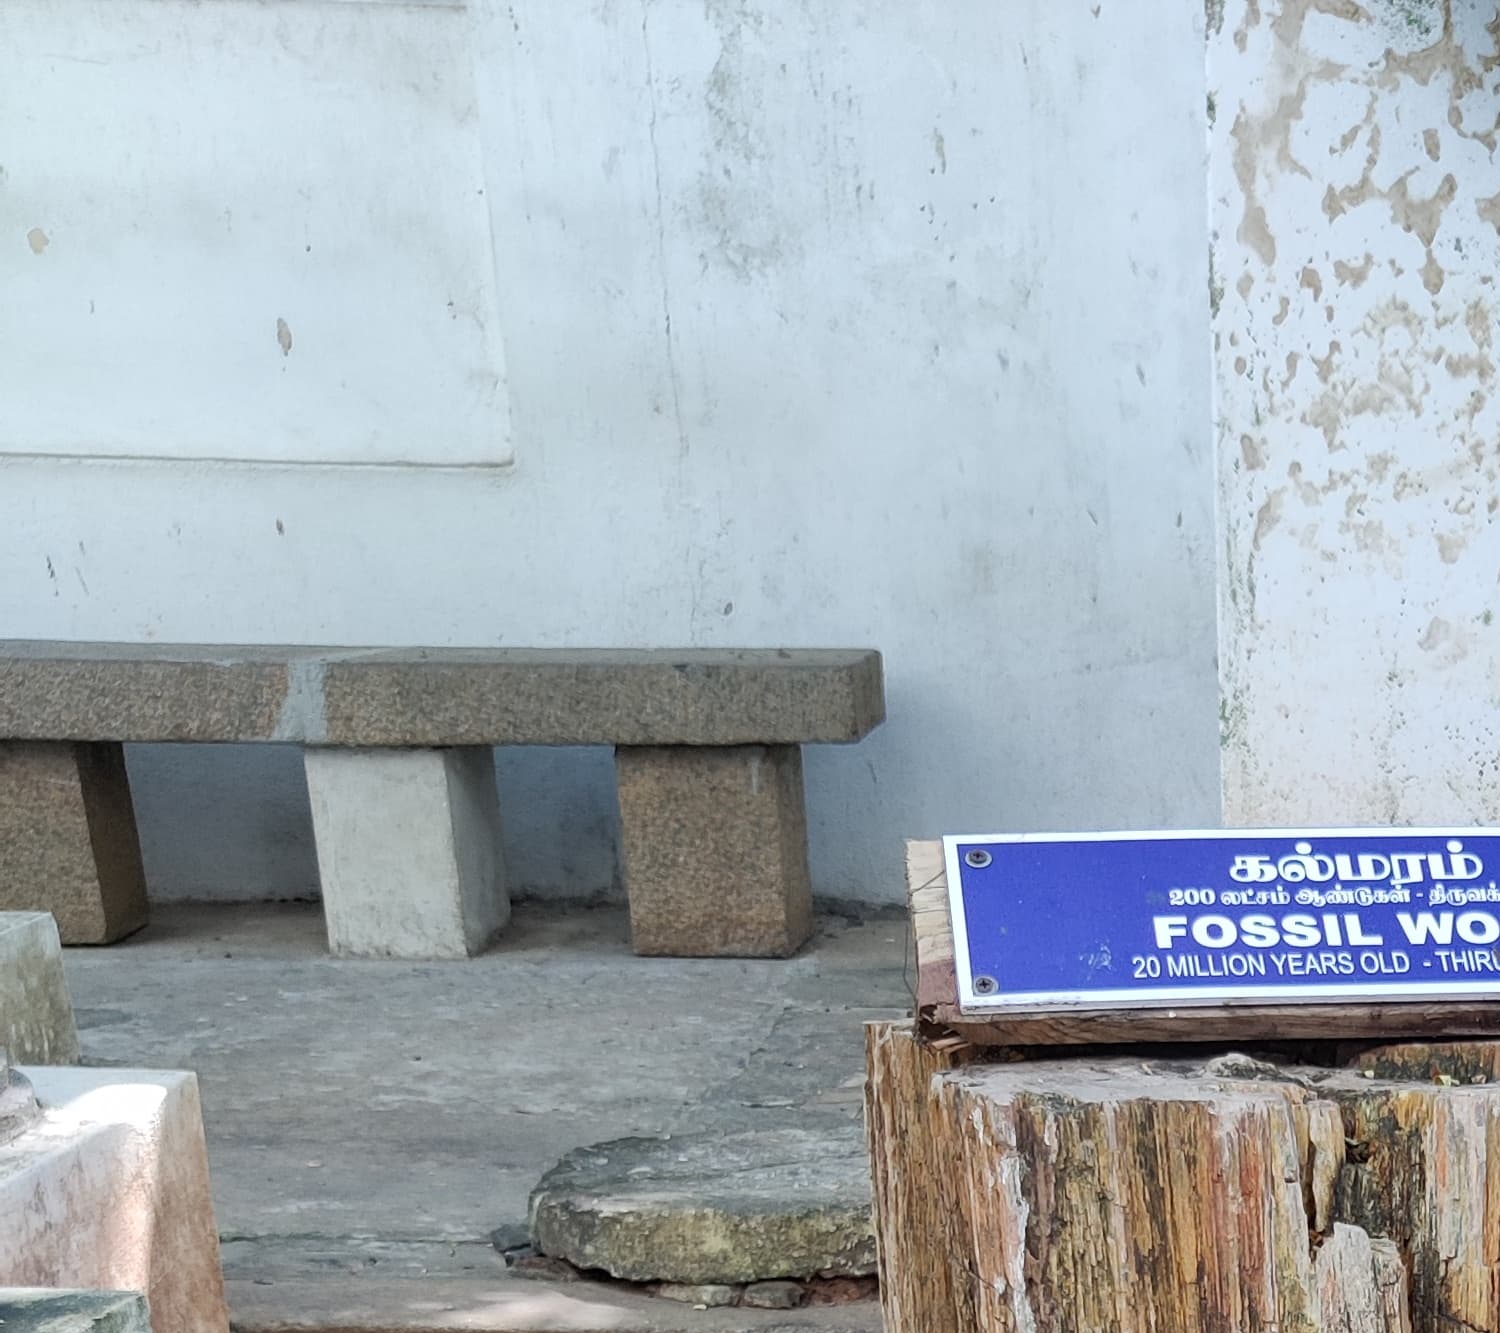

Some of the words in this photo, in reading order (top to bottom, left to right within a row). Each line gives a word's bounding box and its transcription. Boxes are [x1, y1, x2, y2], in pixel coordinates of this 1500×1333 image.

[1229, 841, 1484, 886] கல்மரம்
[1168, 888, 1216, 906] 200
[1220, 884, 1291, 906] லட்சம்
[1294, 883, 1411, 908] ஆண்டுகள்
[1153, 913, 1384, 949] FOSSIL
[1132, 955, 1161, 979] 20
[1166, 953, 1266, 978] MILLION
[1269, 951, 1355, 976] YEARS
[1359, 950, 1410, 975] OLD
